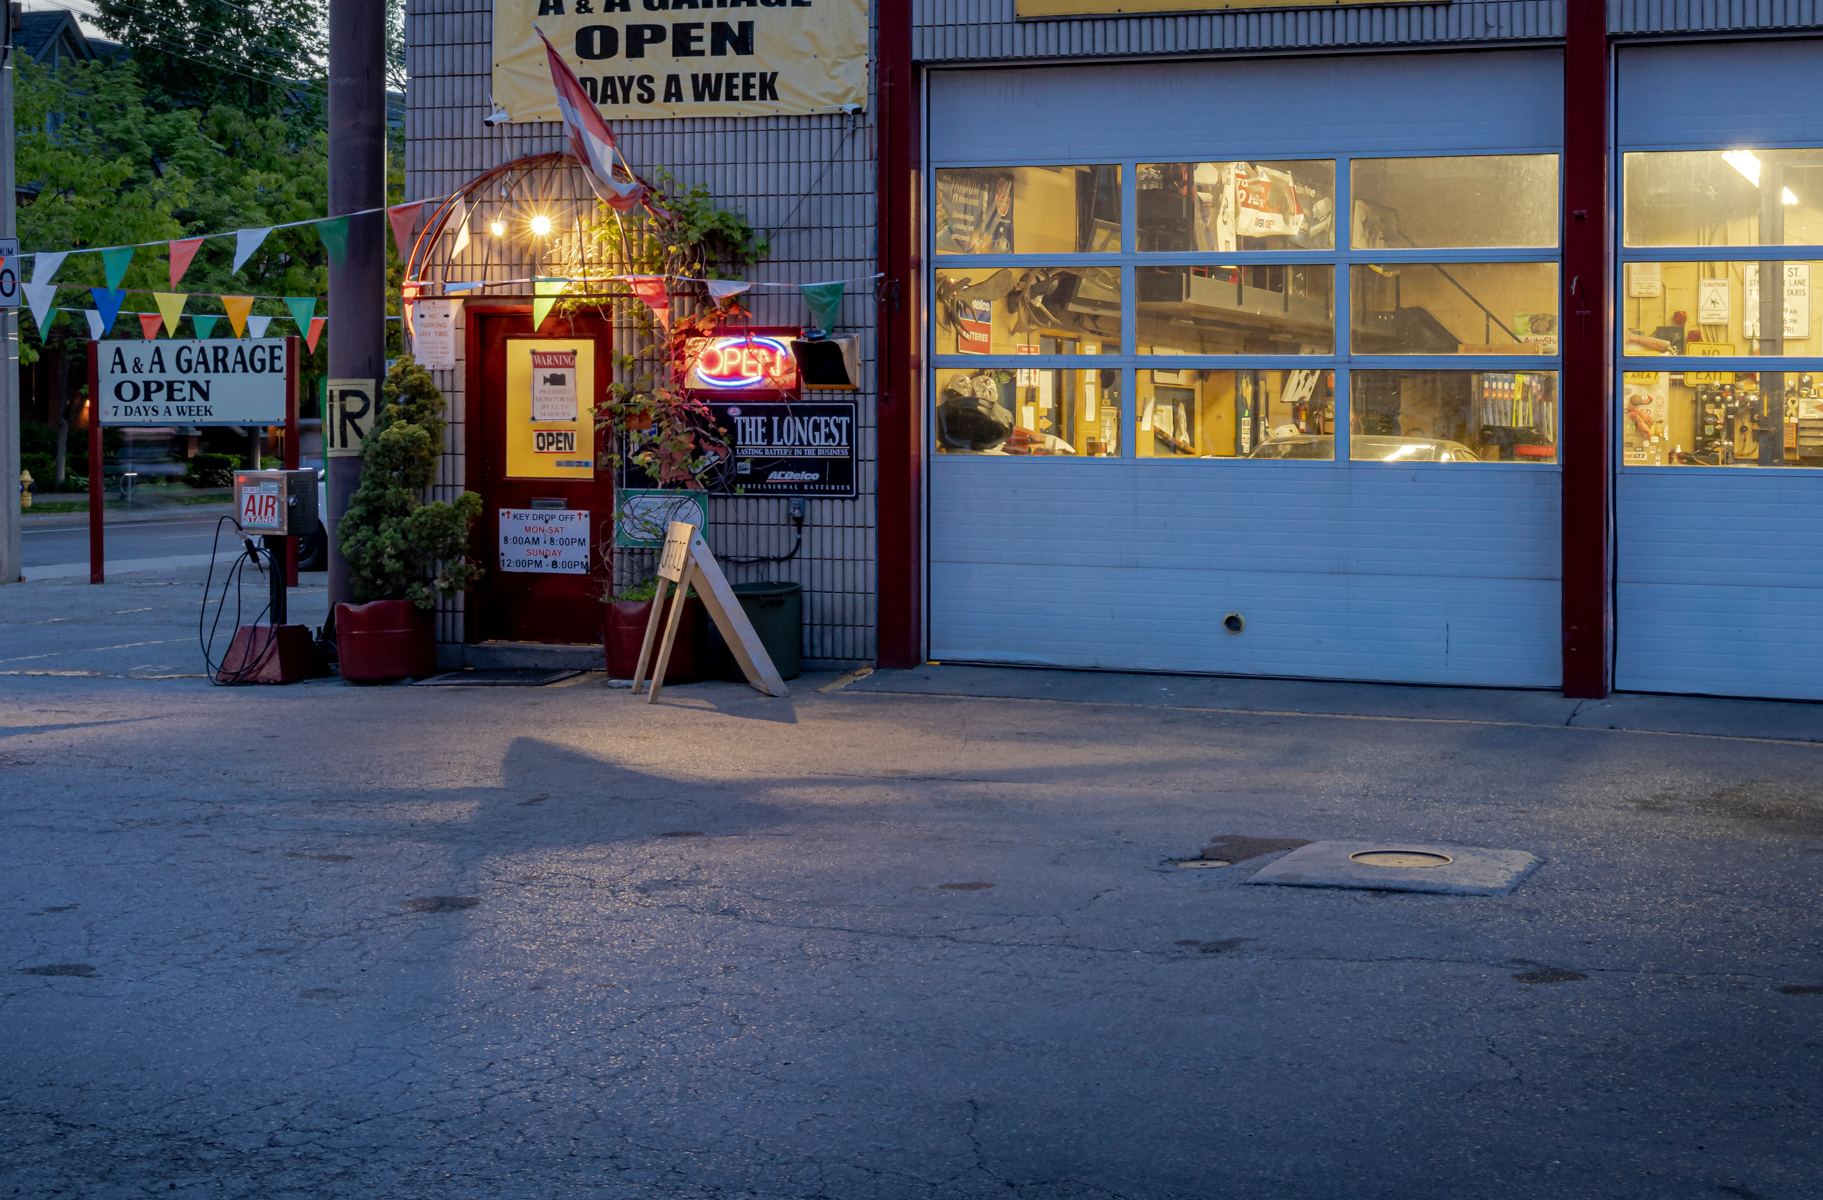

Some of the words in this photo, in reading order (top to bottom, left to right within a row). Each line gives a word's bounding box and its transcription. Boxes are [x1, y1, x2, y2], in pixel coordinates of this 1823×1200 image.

[574, 20, 755, 61] OPEN
[579, 73, 655, 105] DAYS
[662, 73, 685, 103] A
[691, 71, 780, 102] WEEK
[0, 247, 13, 256] UM
[1786, 288, 1806, 296] TAXIS
[110, 346, 128, 374] A
[132, 356, 144, 374] &
[148, 346, 166, 374] A
[175, 344, 284, 374] GARAGE
[533, 354, 575, 366] WARNING
[698, 347, 781, 377] OPEN
[1695, 372, 1722, 380] EXIT
[113, 380, 211, 402] OPEN
[112, 405, 119, 417] 7
[124, 405, 159, 417] DAYS
[163, 405, 172, 416] A
[176, 405, 213, 417] WEEK
[734, 416, 767, 445] THE
[772, 416, 850, 446] LONGEST
[536, 432, 574, 451] OPEN
[764, 448, 792, 456] BATTERY
[794, 448, 802, 456] IN
[767, 471, 820, 480] ACDelco
[244, 494, 276, 517] AIR
[243, 516, 275, 524] STAND
[532, 513, 556, 521] DROP
[524, 526, 564, 534] MON-SAT
[503, 536, 540, 545] 8:00AM
[549, 537, 586, 546] 8:00PM
[526, 548, 563, 557] SUNDAY
[501, 559, 542, 568] 12:00PM
[551, 560, 588, 570] 8:00PM
